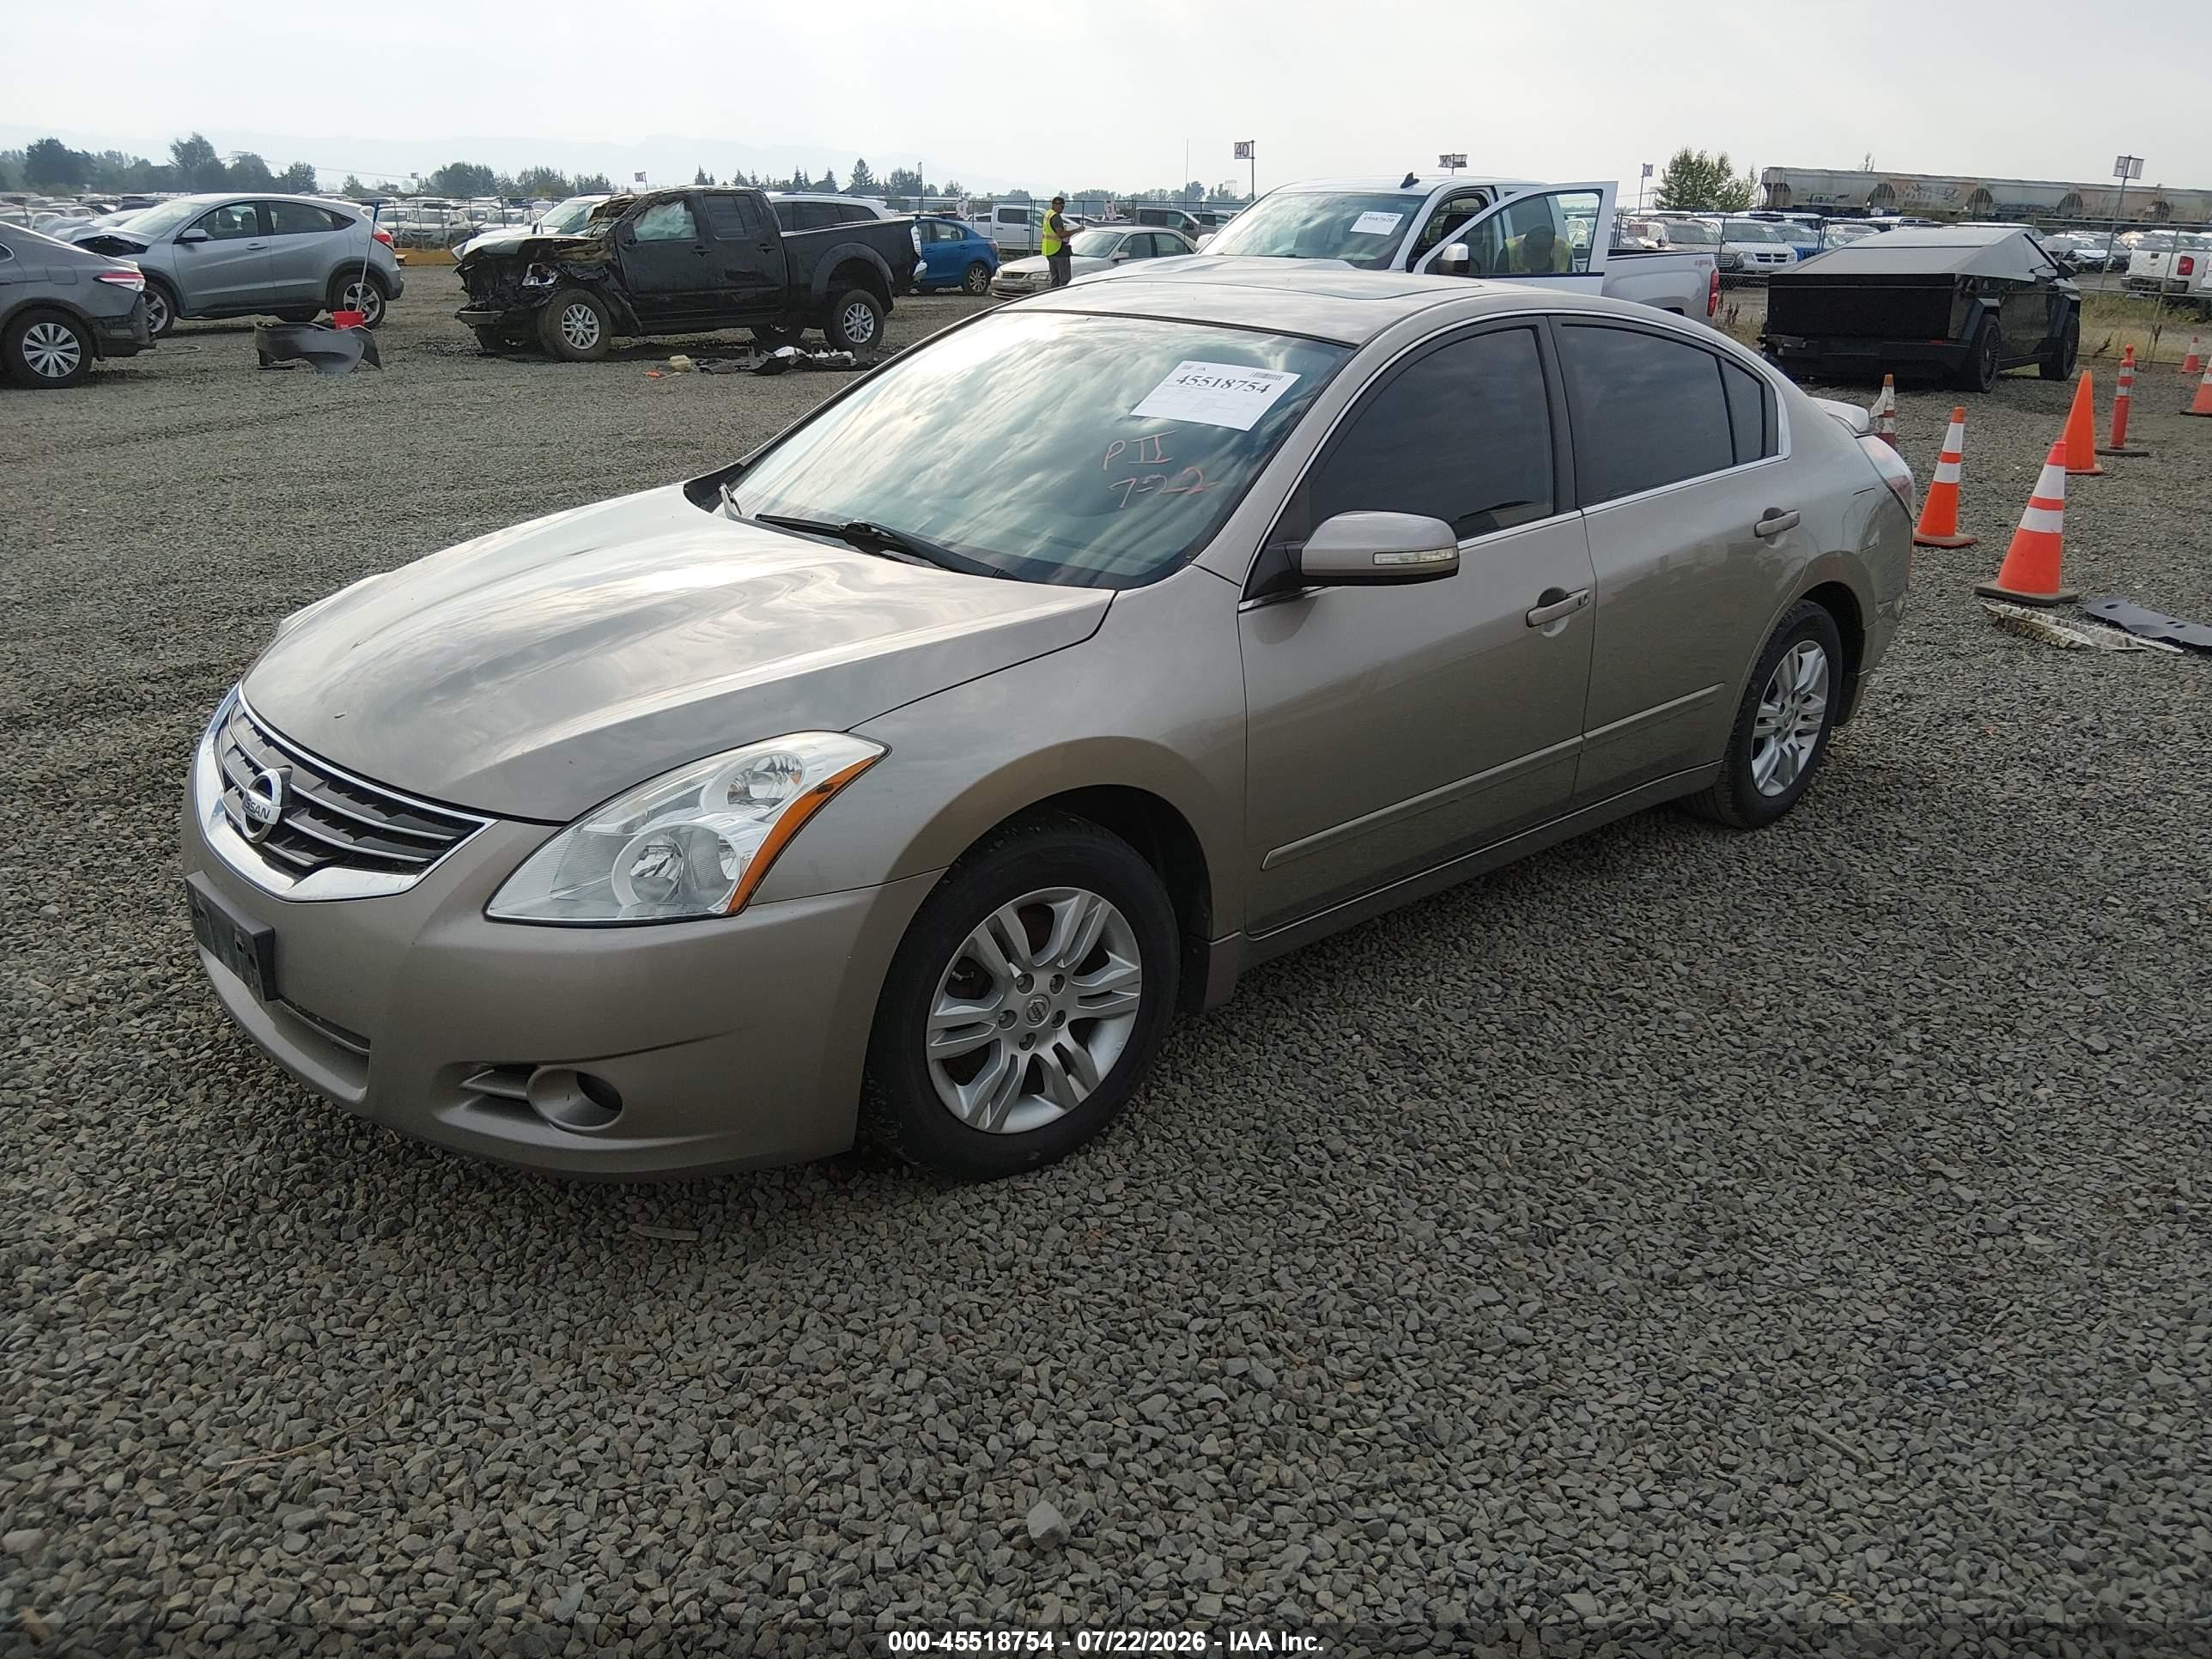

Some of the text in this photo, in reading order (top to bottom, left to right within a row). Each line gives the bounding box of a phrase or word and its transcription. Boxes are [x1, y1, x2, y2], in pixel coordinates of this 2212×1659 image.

[1236, 143, 1249, 157] 40
[1176, 374, 1272, 394] 45518754
[245, 796, 271, 819] SSAN
